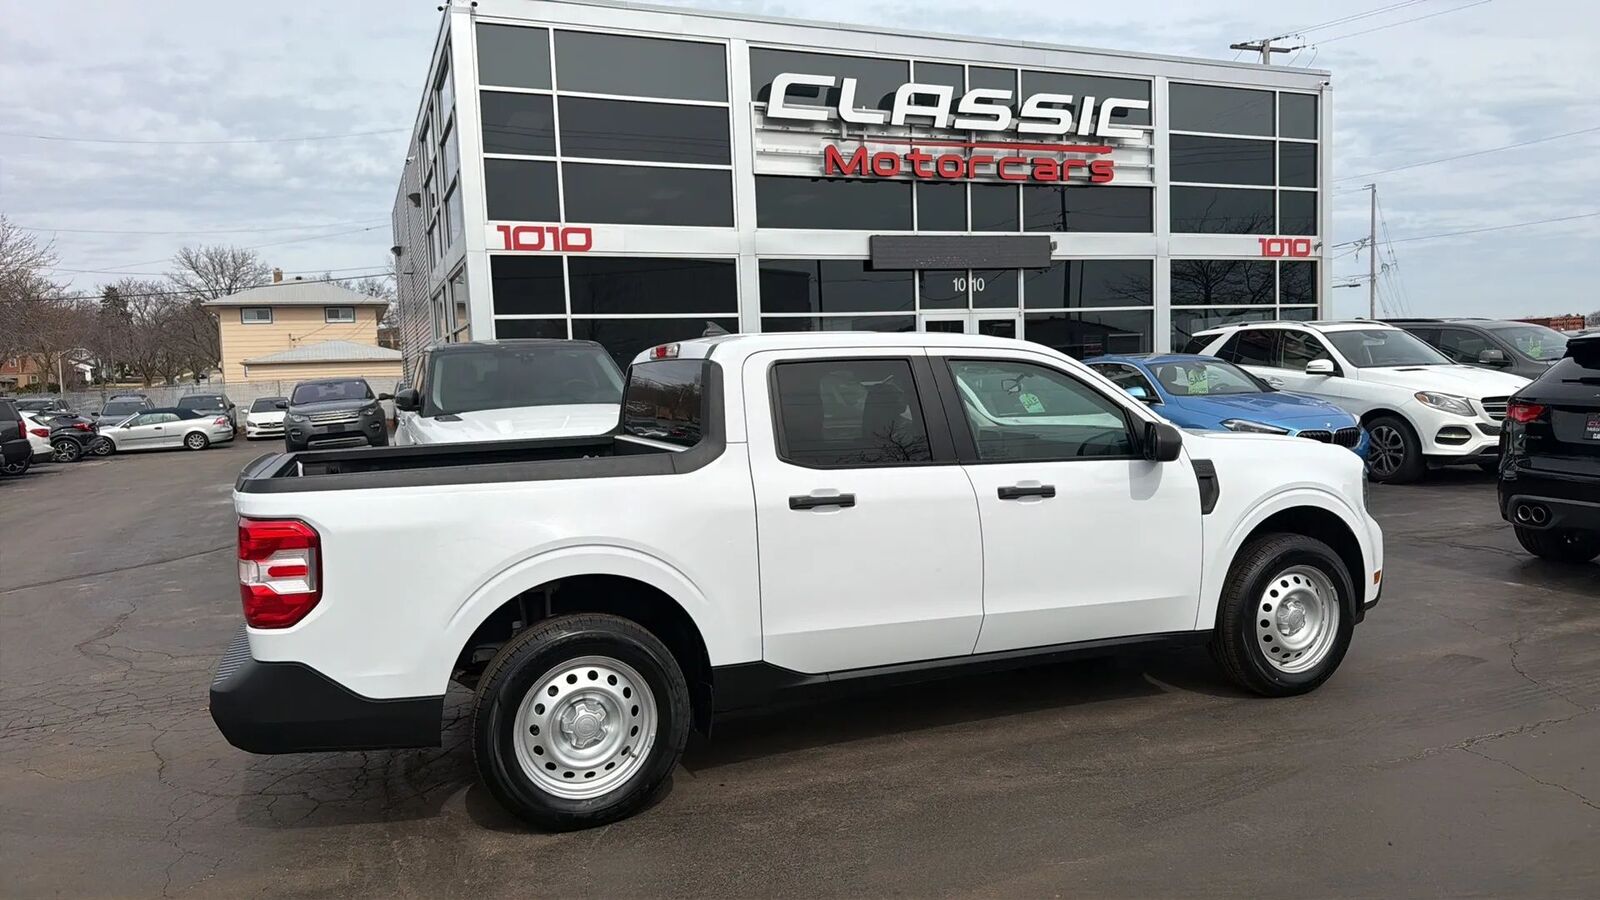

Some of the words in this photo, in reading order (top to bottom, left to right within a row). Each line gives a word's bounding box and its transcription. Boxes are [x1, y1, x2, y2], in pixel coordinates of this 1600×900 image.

[766, 73, 1150, 138] CLASSIC
[824, 145, 1114, 184] Motorcars
[496, 225, 593, 252] 1010
[1258, 238, 1311, 257] 1010
